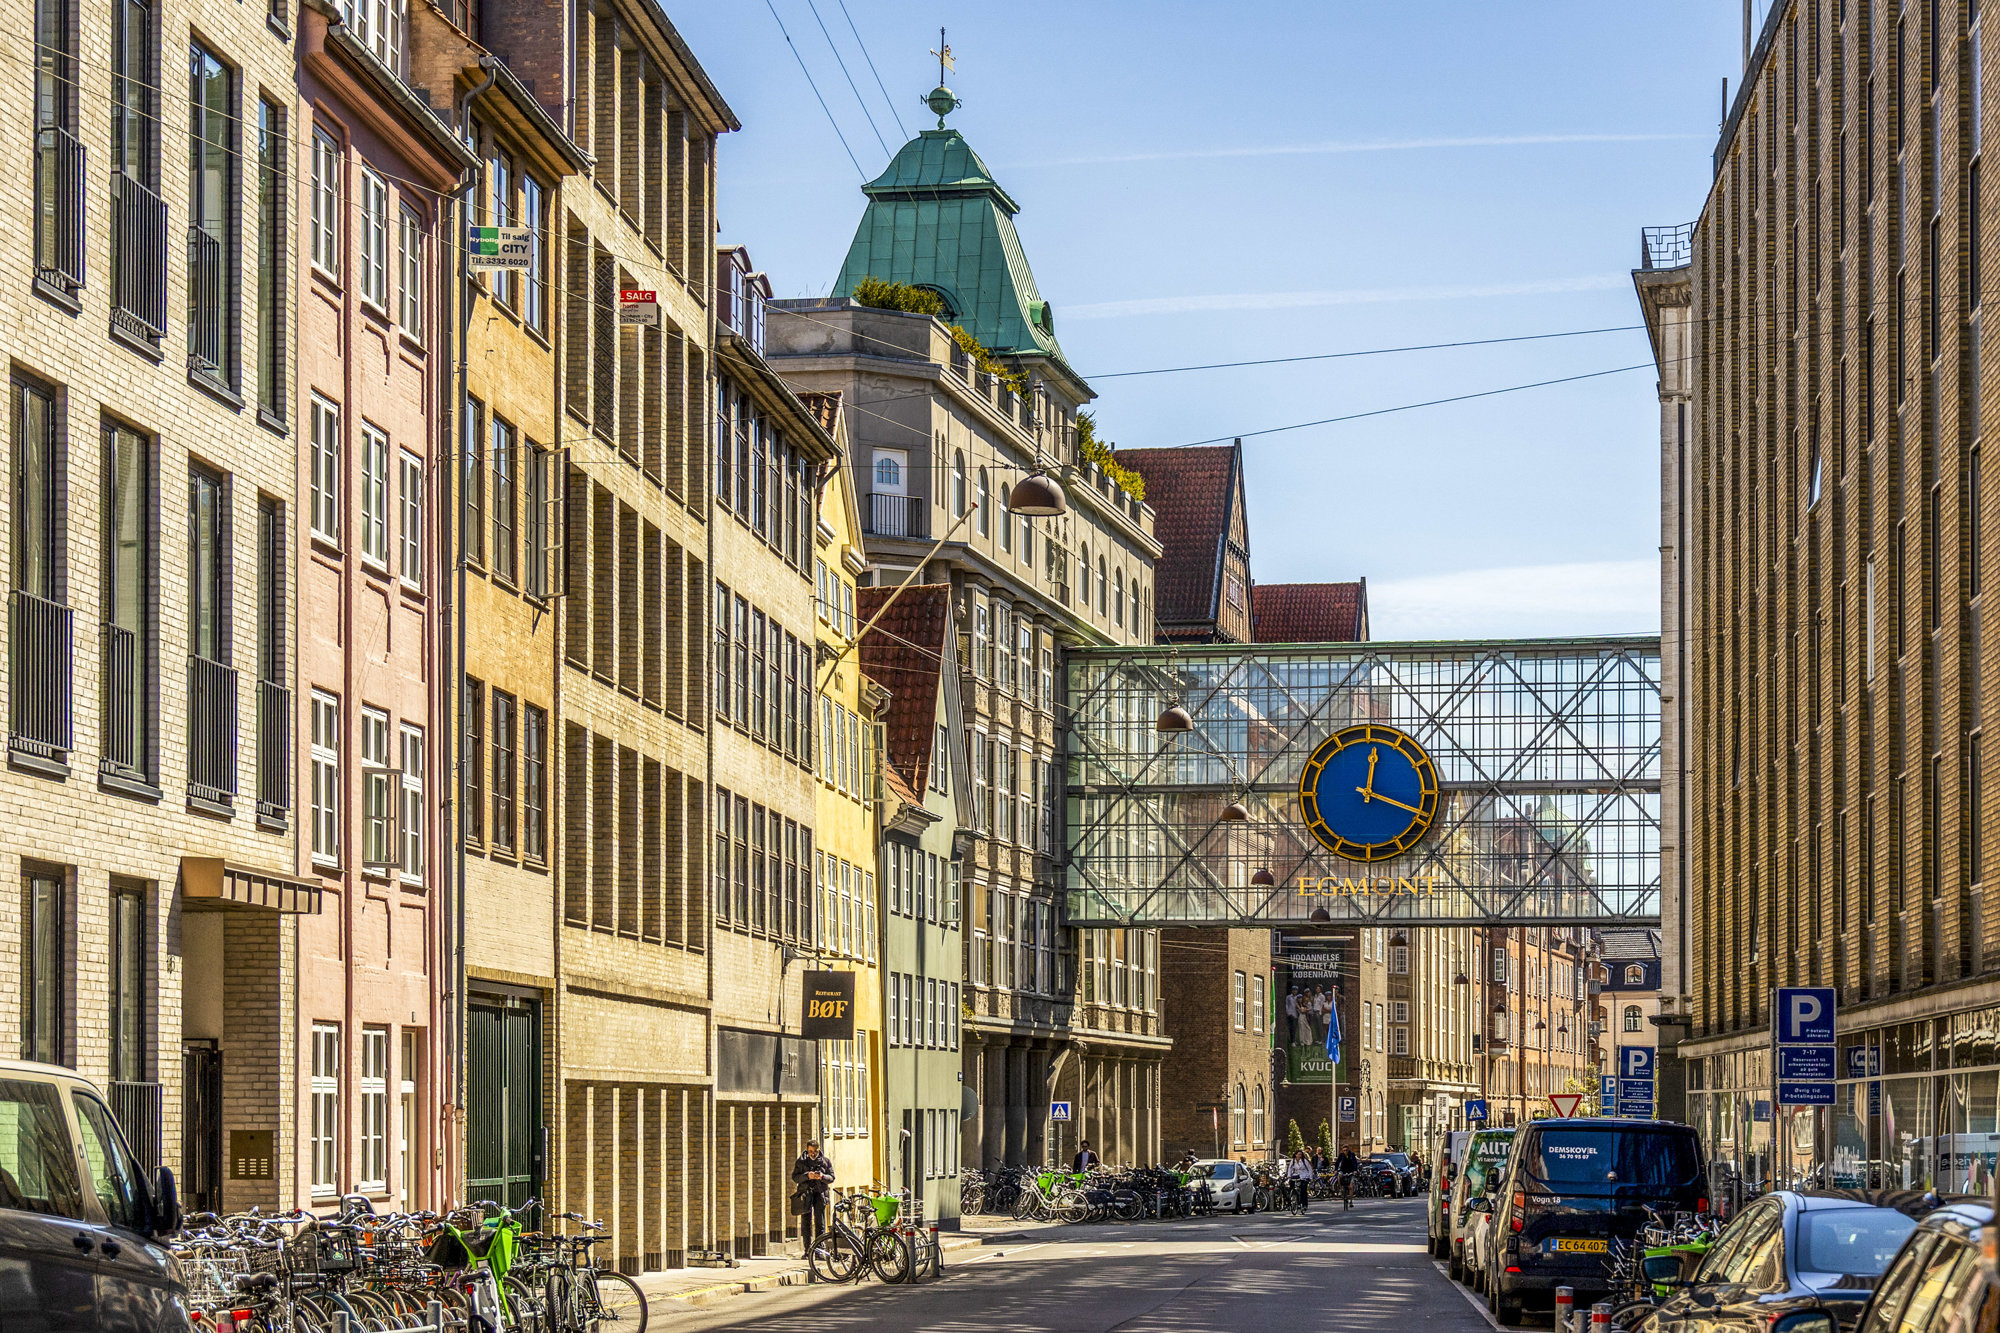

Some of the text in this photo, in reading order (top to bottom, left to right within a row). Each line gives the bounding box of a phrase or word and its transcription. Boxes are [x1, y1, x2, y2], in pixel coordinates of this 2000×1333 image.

[501, 232, 530, 242] Til salg
[501, 243, 528, 254] CITY
[508, 258, 529, 266] 6020
[626, 292, 653, 301] SALG
[1297, 876, 1440, 896] EGMONT
[1290, 953, 1340, 961] UDDANNELSE
[1296, 962, 1328, 970] HJERTET
[1329, 961, 1338, 970] AF
[1292, 970, 1339, 979] KØBENHAVN
[808, 999, 849, 1019] BØF
[1791, 994, 1822, 1037] P
[1300, 1061, 1332, 1071] KVUC
[1628, 1049, 1648, 1076] P
[1605, 1077, 1616, 1093] P
[1343, 1098, 1353, 1111] P
[1532, 1195, 1561, 1204] Vogn 18
[1558, 1241, 1606, 1252] EC 64 407
